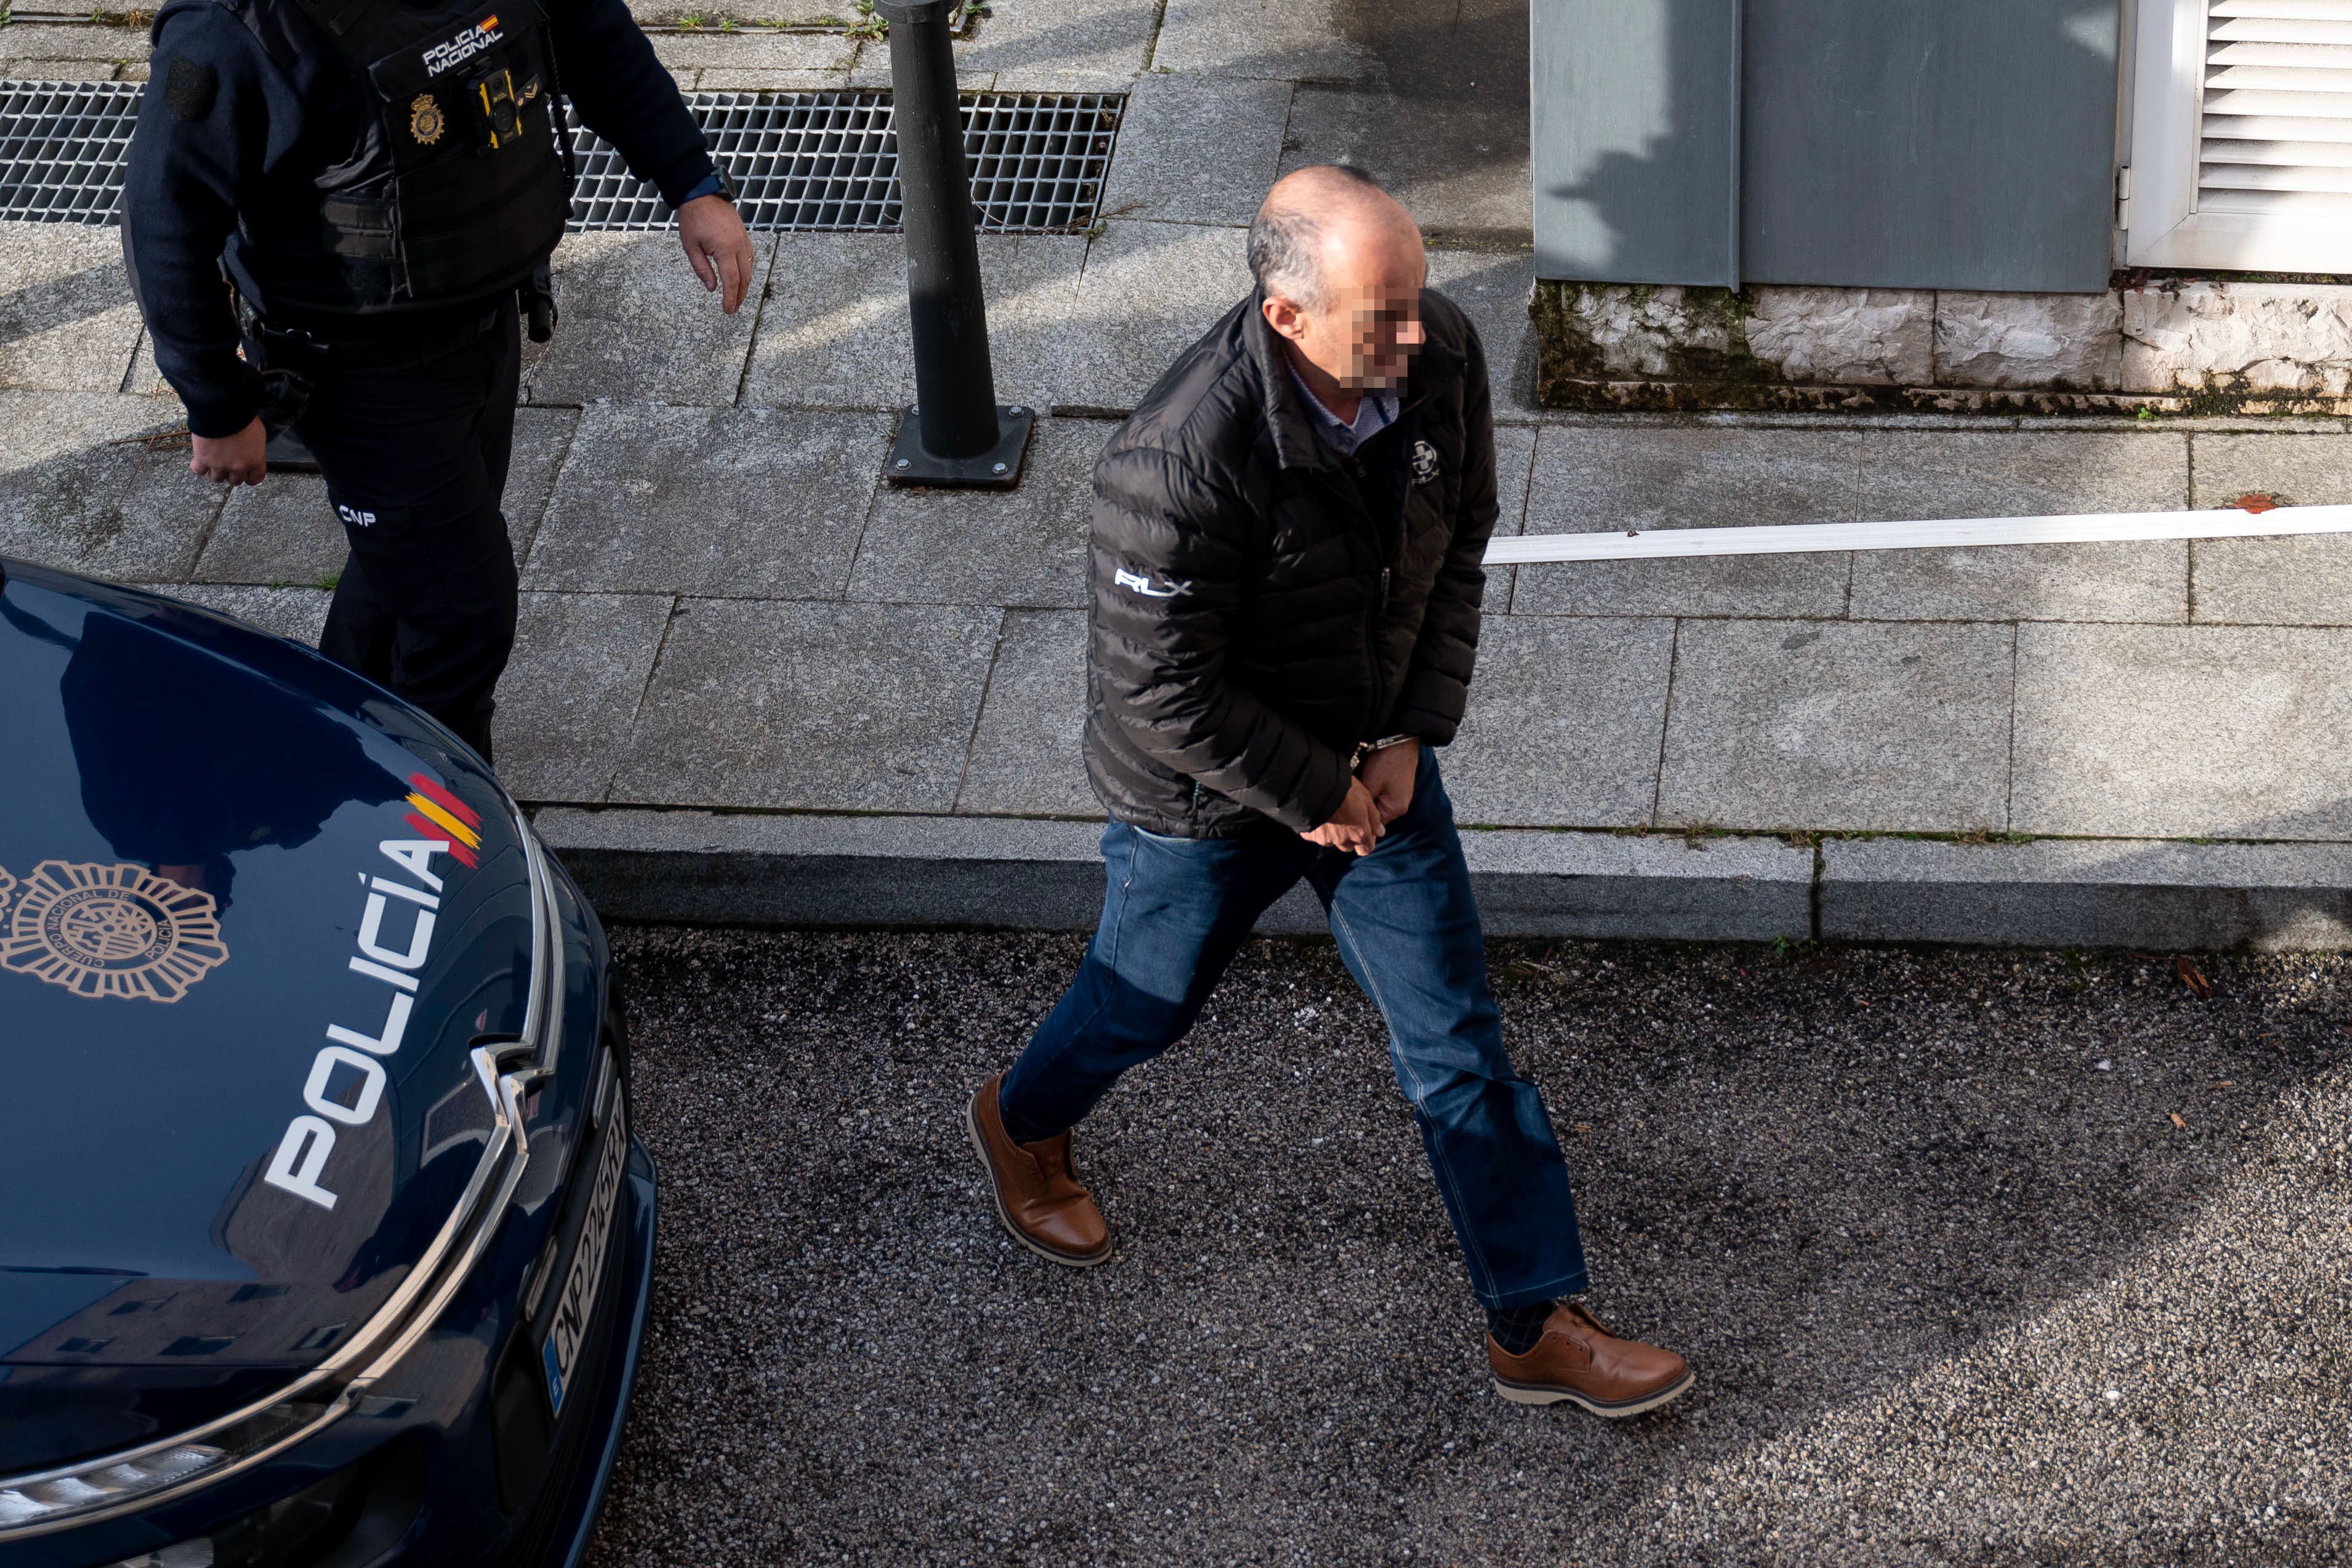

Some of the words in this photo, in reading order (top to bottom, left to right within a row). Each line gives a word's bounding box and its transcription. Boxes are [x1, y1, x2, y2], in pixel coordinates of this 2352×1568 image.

[422, 25, 486, 65] POLICIA
[428, 30, 503, 77] NACIONAL
[1411, 468, 1439, 485] RLX
[339, 505, 376, 527] CNP
[1114, 568, 1194, 597] RLX
[47, 890, 103, 930] NACIONAL
[108, 890, 131, 901] DE
[49, 933, 105, 968] CUERPO
[264, 840, 450, 1211] POLICÍA
